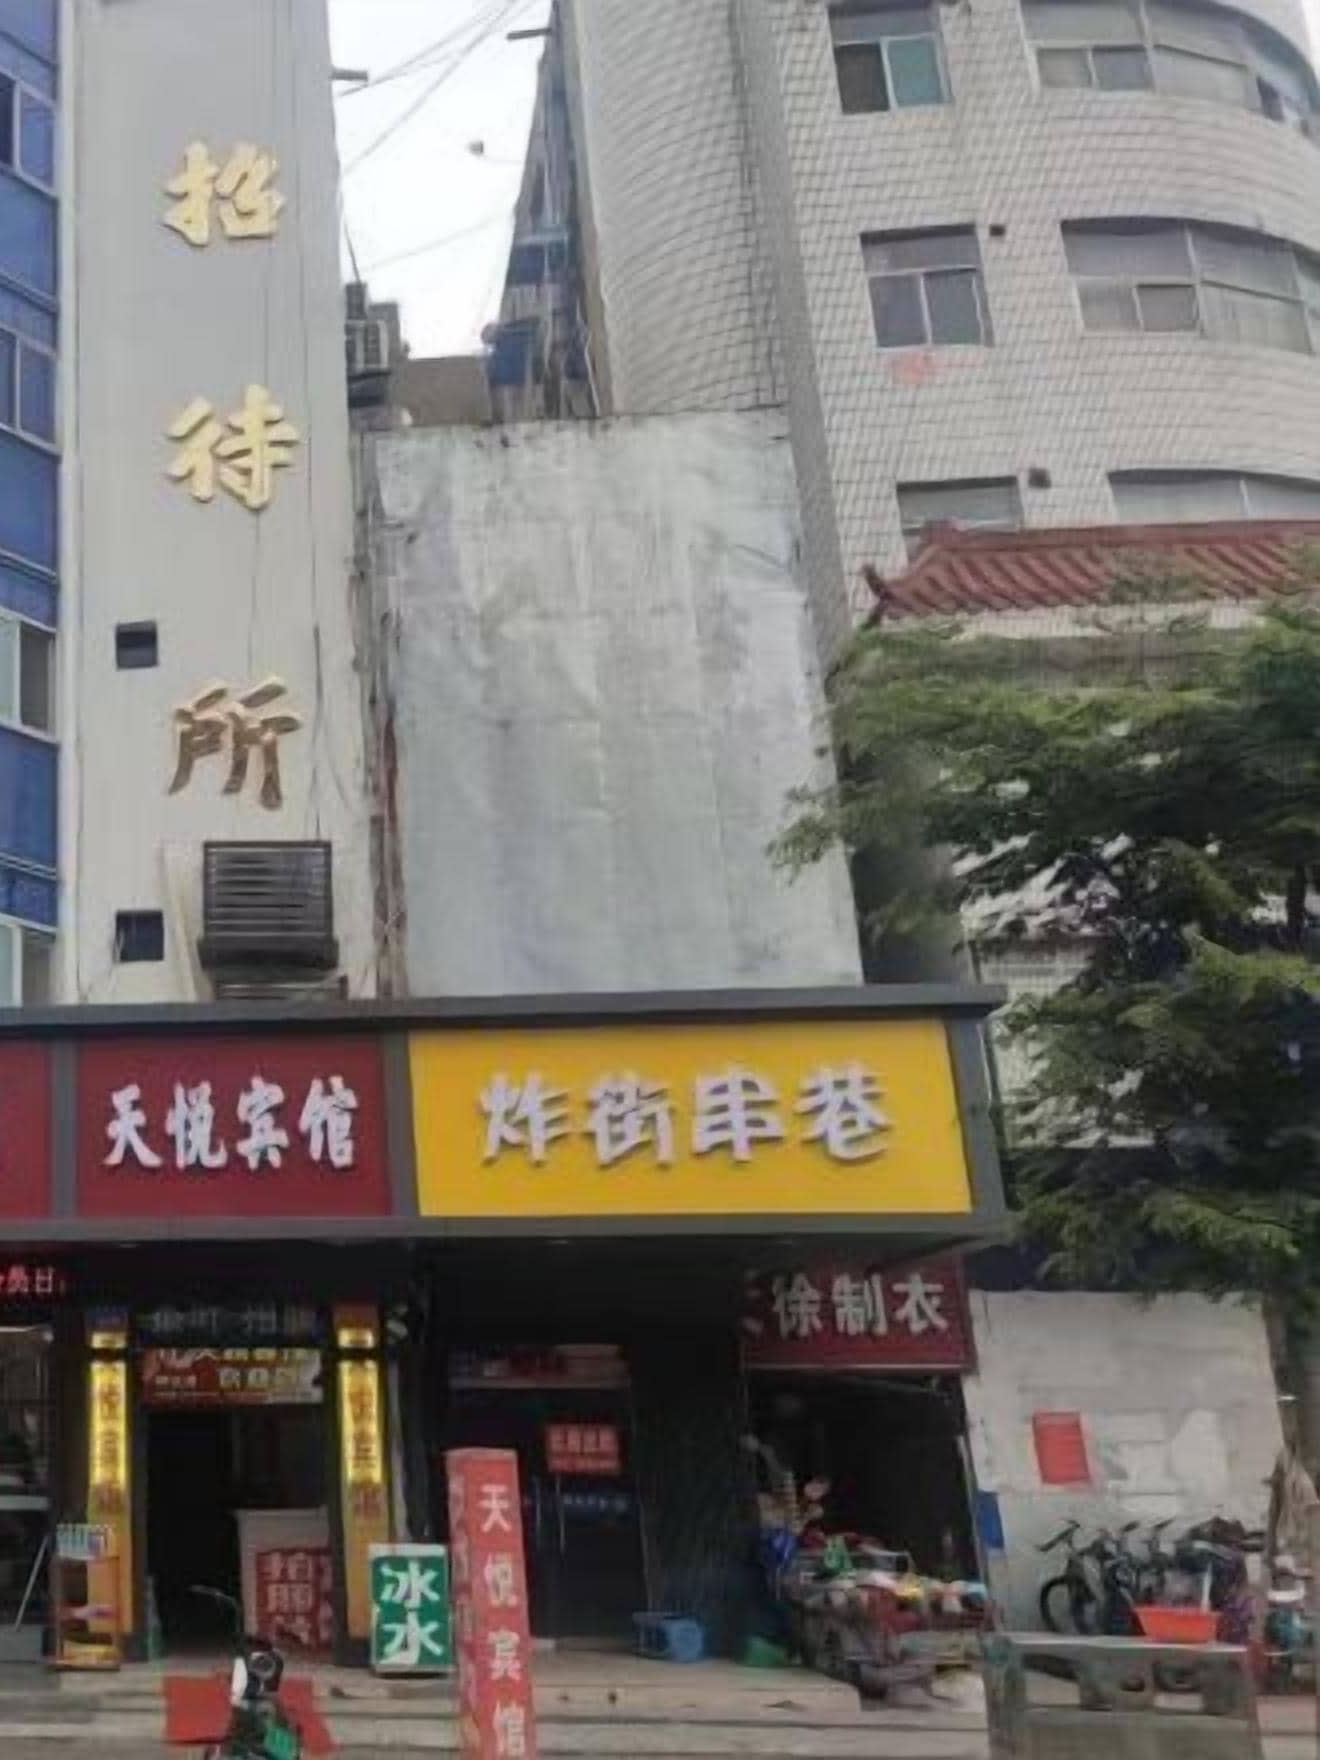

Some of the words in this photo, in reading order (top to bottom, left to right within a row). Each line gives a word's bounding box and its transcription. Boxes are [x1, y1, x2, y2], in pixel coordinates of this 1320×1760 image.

[161, 138, 303, 811] 招待所
[102, 1075, 359, 1170] 天悦宾馆
[478, 1064, 891, 1169] 炸街串巷
[742, 1269, 948, 1338] 徐制衣
[380, 1560, 444, 1665] 冰水
